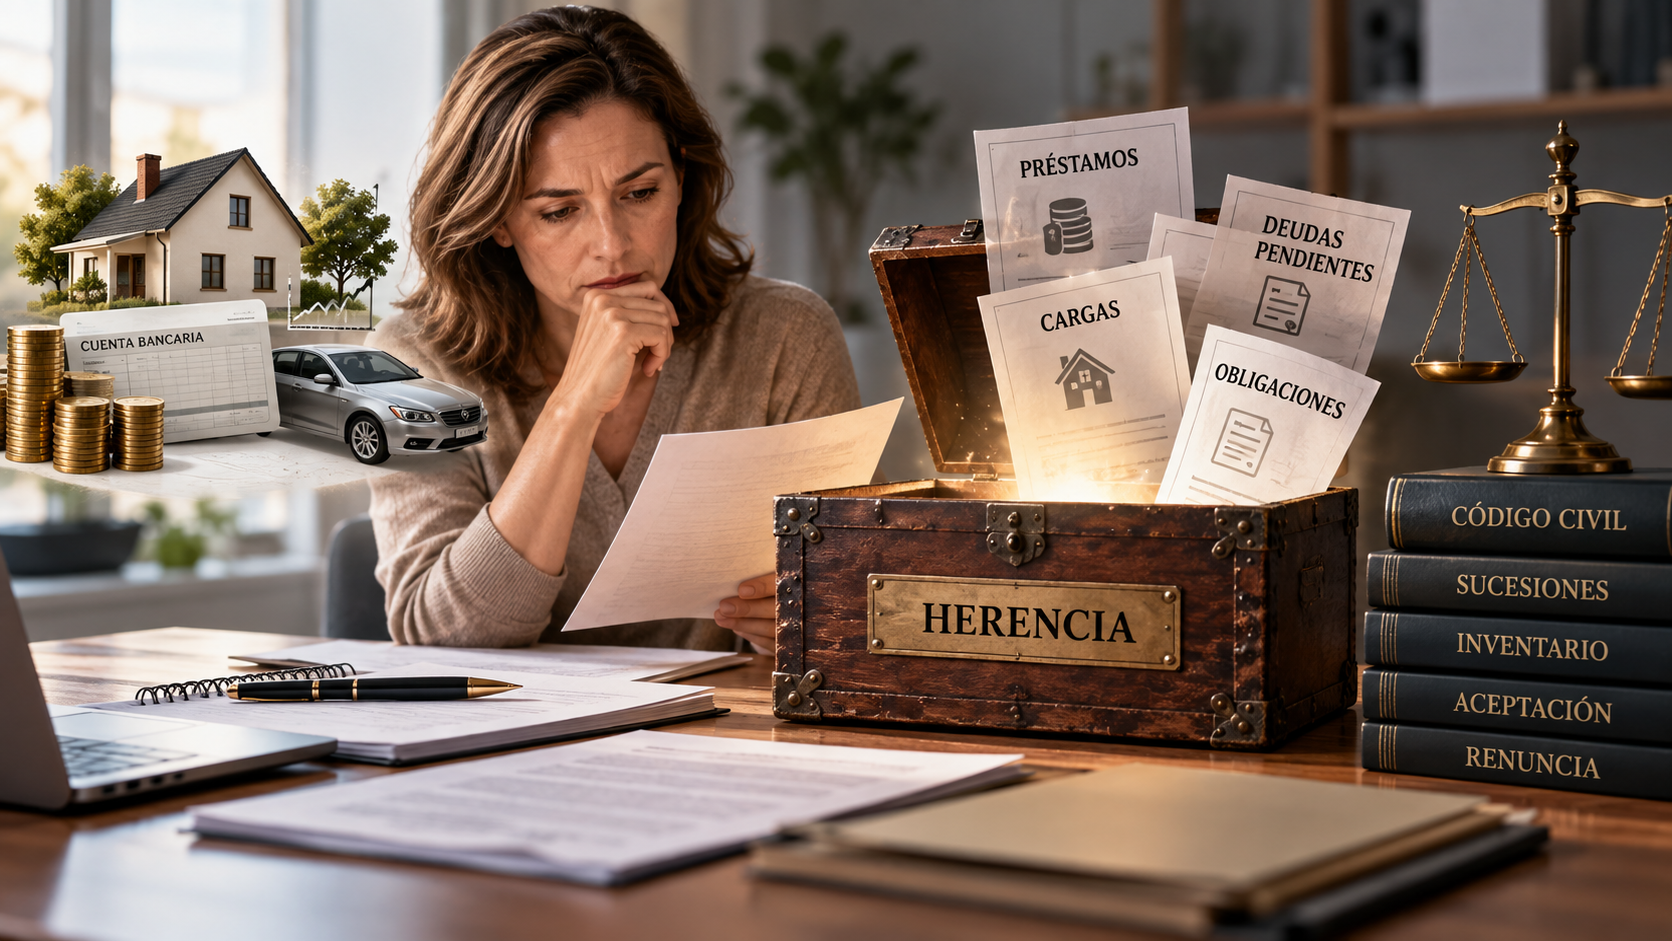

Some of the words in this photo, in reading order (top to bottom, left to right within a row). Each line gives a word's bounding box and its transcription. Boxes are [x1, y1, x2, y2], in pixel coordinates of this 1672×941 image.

[1020, 147, 1139, 178] PRÉSTAMOS
[1262, 215, 1345, 249] DEUDAS
[1254, 241, 1375, 283] PENDIENTES
[1040, 300, 1121, 332] CARGAS
[80, 337, 135, 352] CUENTA
[138, 332, 204, 348] BANCARIA
[1215, 363, 1346, 420] OBLIGACIONES
[1451, 502, 1551, 528] CÓDIGO
[1558, 509, 1628, 531] CIVIL
[1456, 574, 1609, 601] SUCESIONES
[922, 602, 1137, 643] HERENCIA
[1456, 632, 1609, 661] INVENTARIO
[1453, 692, 1613, 724] ACEPTACIÓN
[1465, 746, 1601, 779] RENUNCIA
